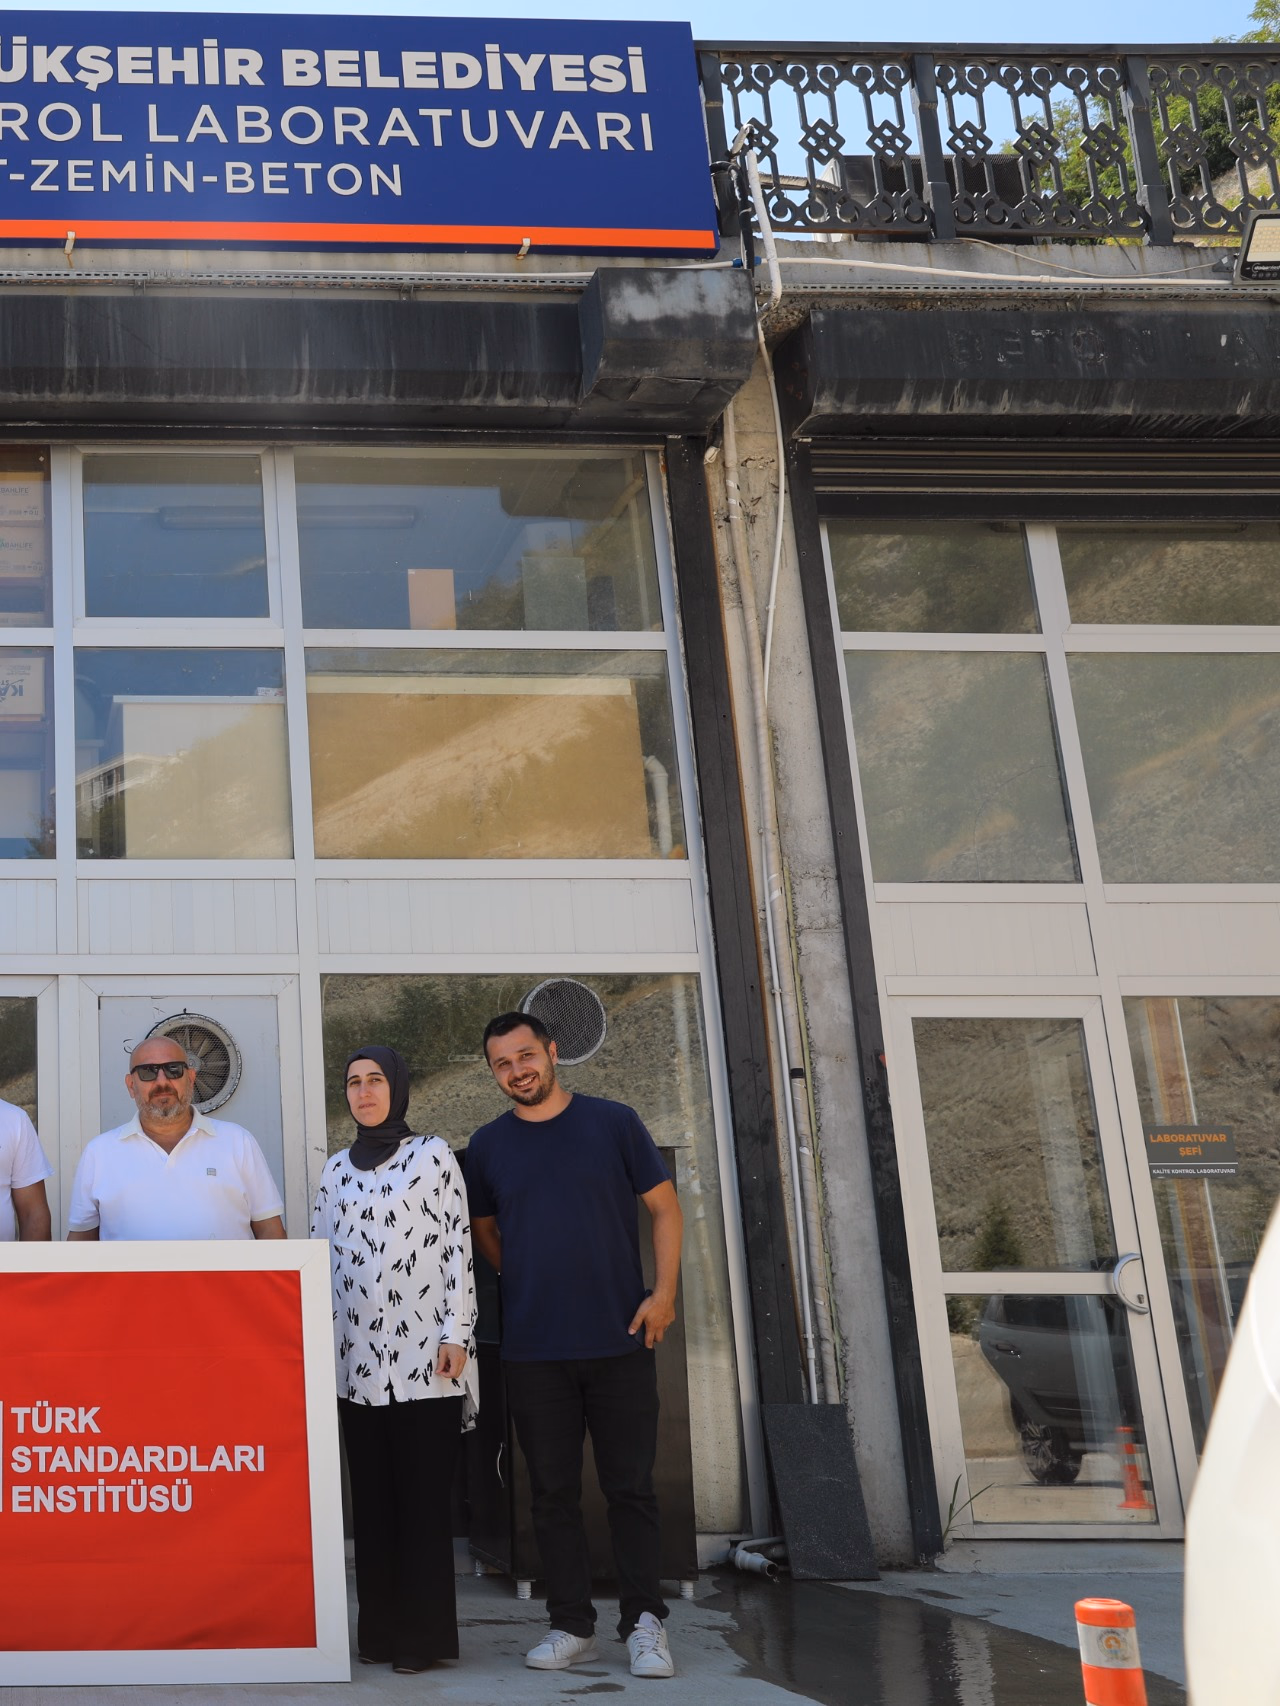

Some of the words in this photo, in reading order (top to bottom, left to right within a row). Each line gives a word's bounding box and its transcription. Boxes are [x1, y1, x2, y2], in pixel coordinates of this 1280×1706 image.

[282, 43, 647, 93] BELEDİYESİ
[147, 103, 654, 151] LABORATUVARI
[1149, 1133, 1227, 1143] LABORATUVAR
[1178, 1145, 1203, 1157] ŞEFİ
[11, 1400, 101, 1434] TÜRK
[11, 1445, 265, 1473] STANDARDLARI
[11, 1478, 193, 1513] ENSTİTÜSÜ
